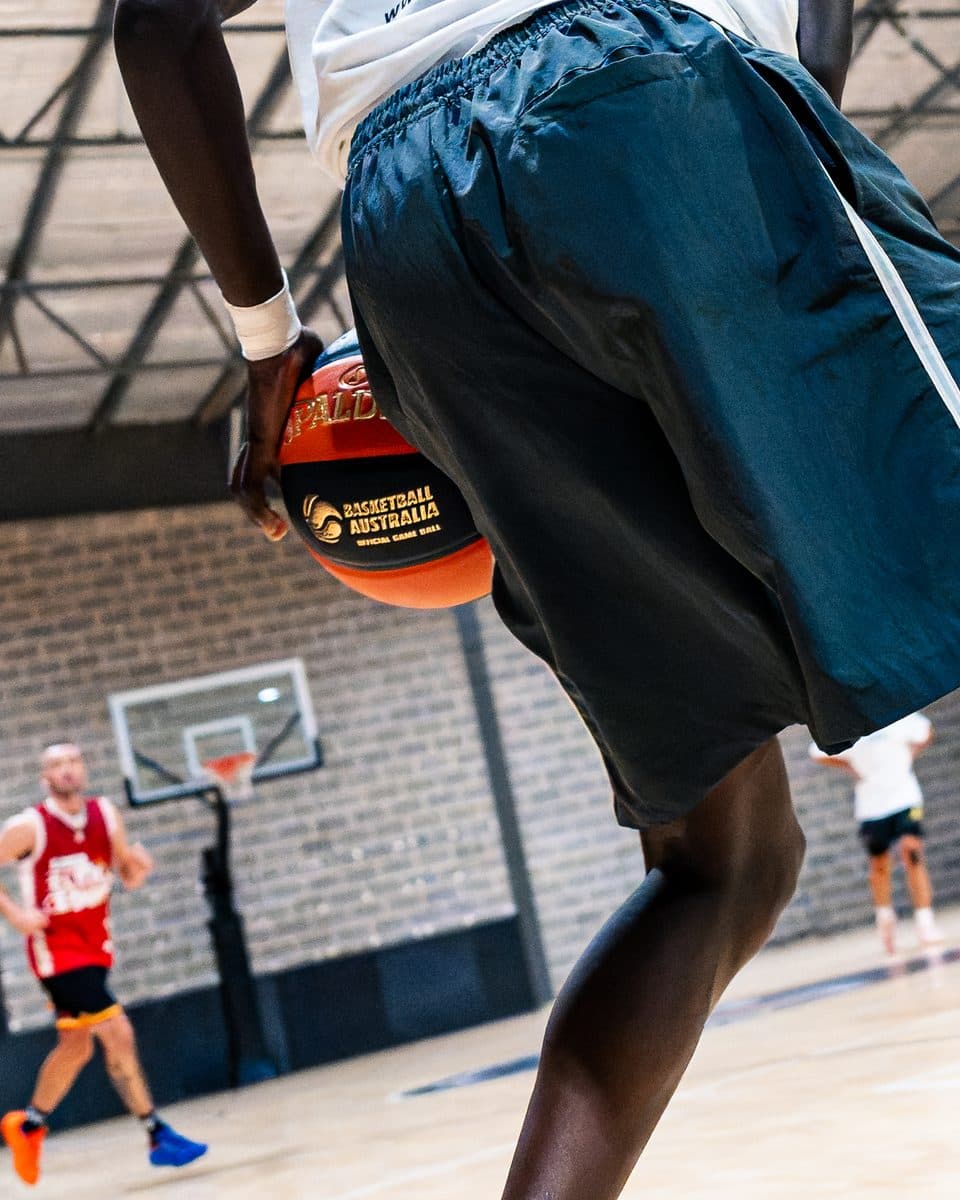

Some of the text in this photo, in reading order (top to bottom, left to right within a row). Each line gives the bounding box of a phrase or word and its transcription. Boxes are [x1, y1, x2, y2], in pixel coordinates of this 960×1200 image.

[344, 485, 433, 518] BASKETBALL
[350, 501, 440, 535] AUSTRALIA
[392, 531, 418, 542] GAME
[419, 525, 441, 536] BALL
